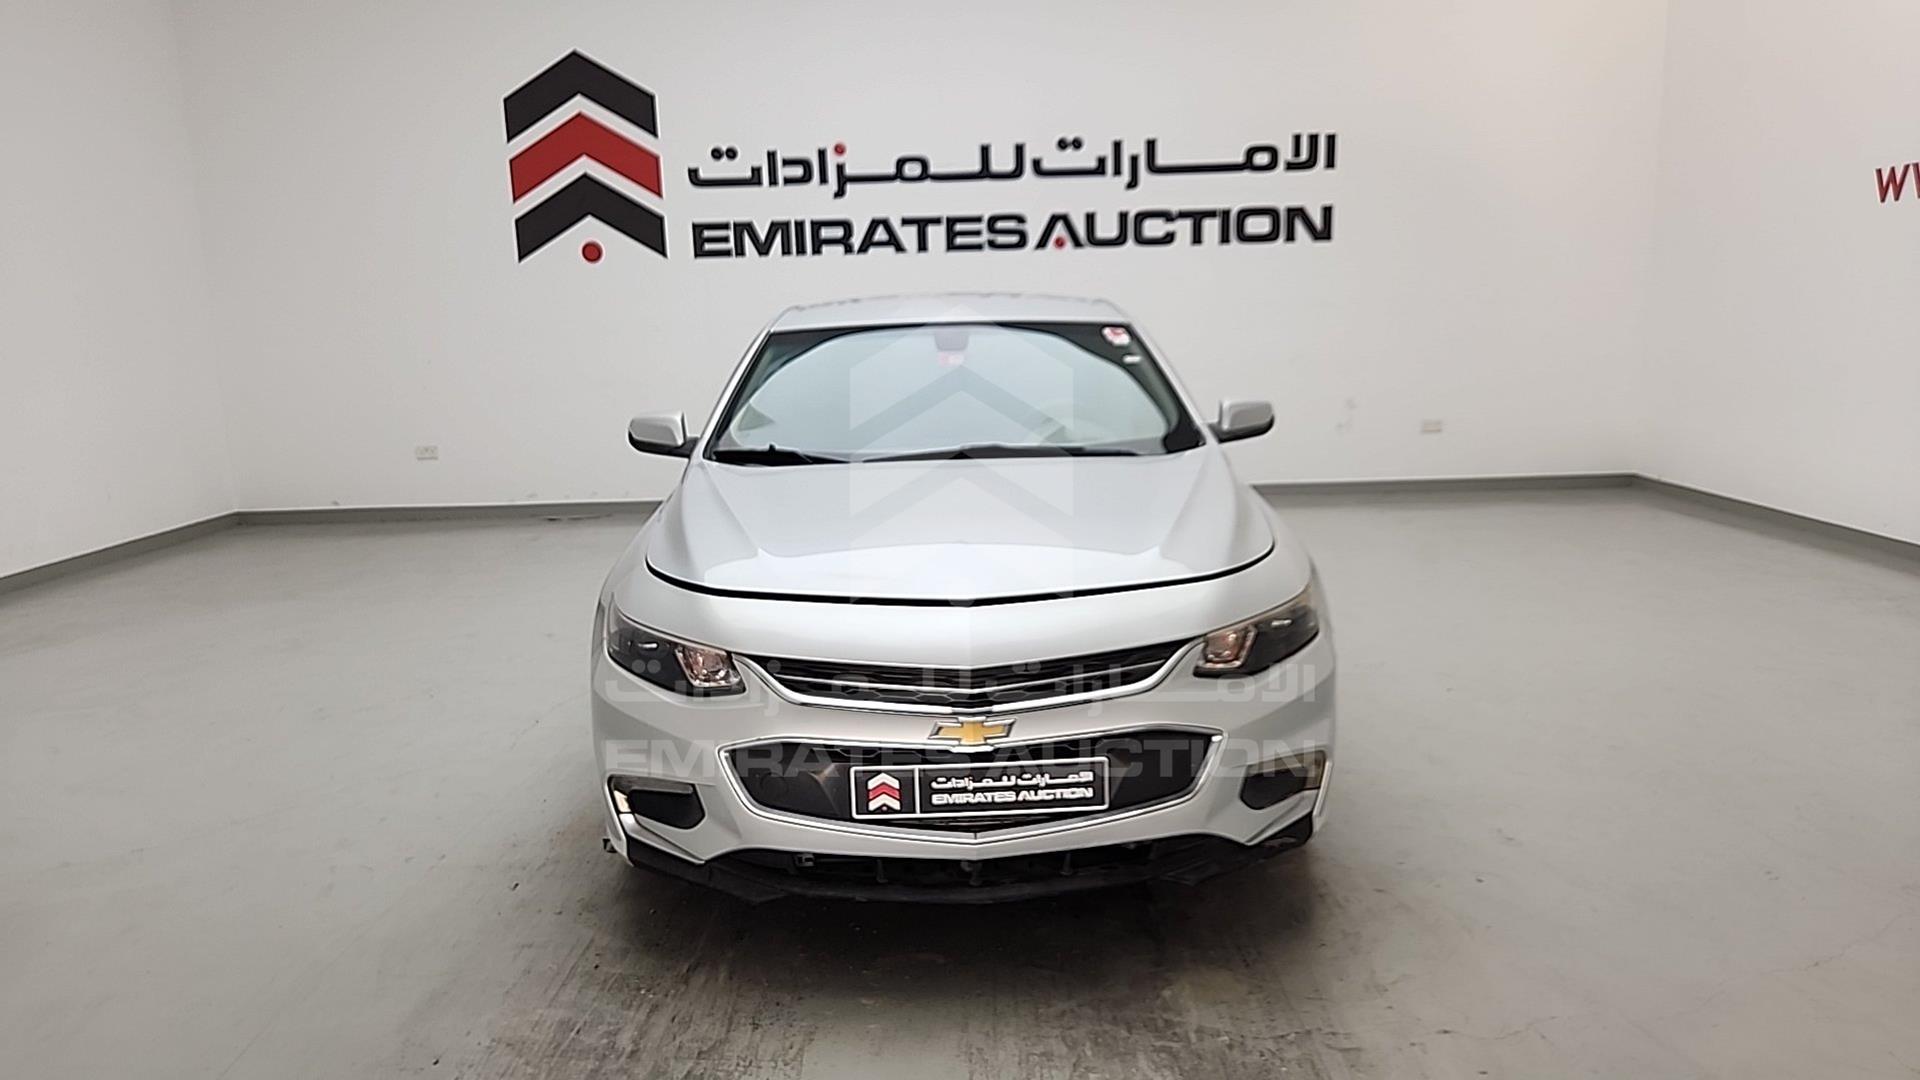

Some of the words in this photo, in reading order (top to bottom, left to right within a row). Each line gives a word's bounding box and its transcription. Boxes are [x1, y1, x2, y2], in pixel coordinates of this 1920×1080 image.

[688, 143, 1025, 199] للمزادات
[1032, 133, 1336, 190] الامارات
[1875, 162, 1920, 203] W
[692, 214, 1028, 259] EMIRATES
[1034, 205, 1333, 251] AUCTION
[932, 791, 1015, 804] EMIRATES
[1016, 787, 1094, 802] AUCTION
